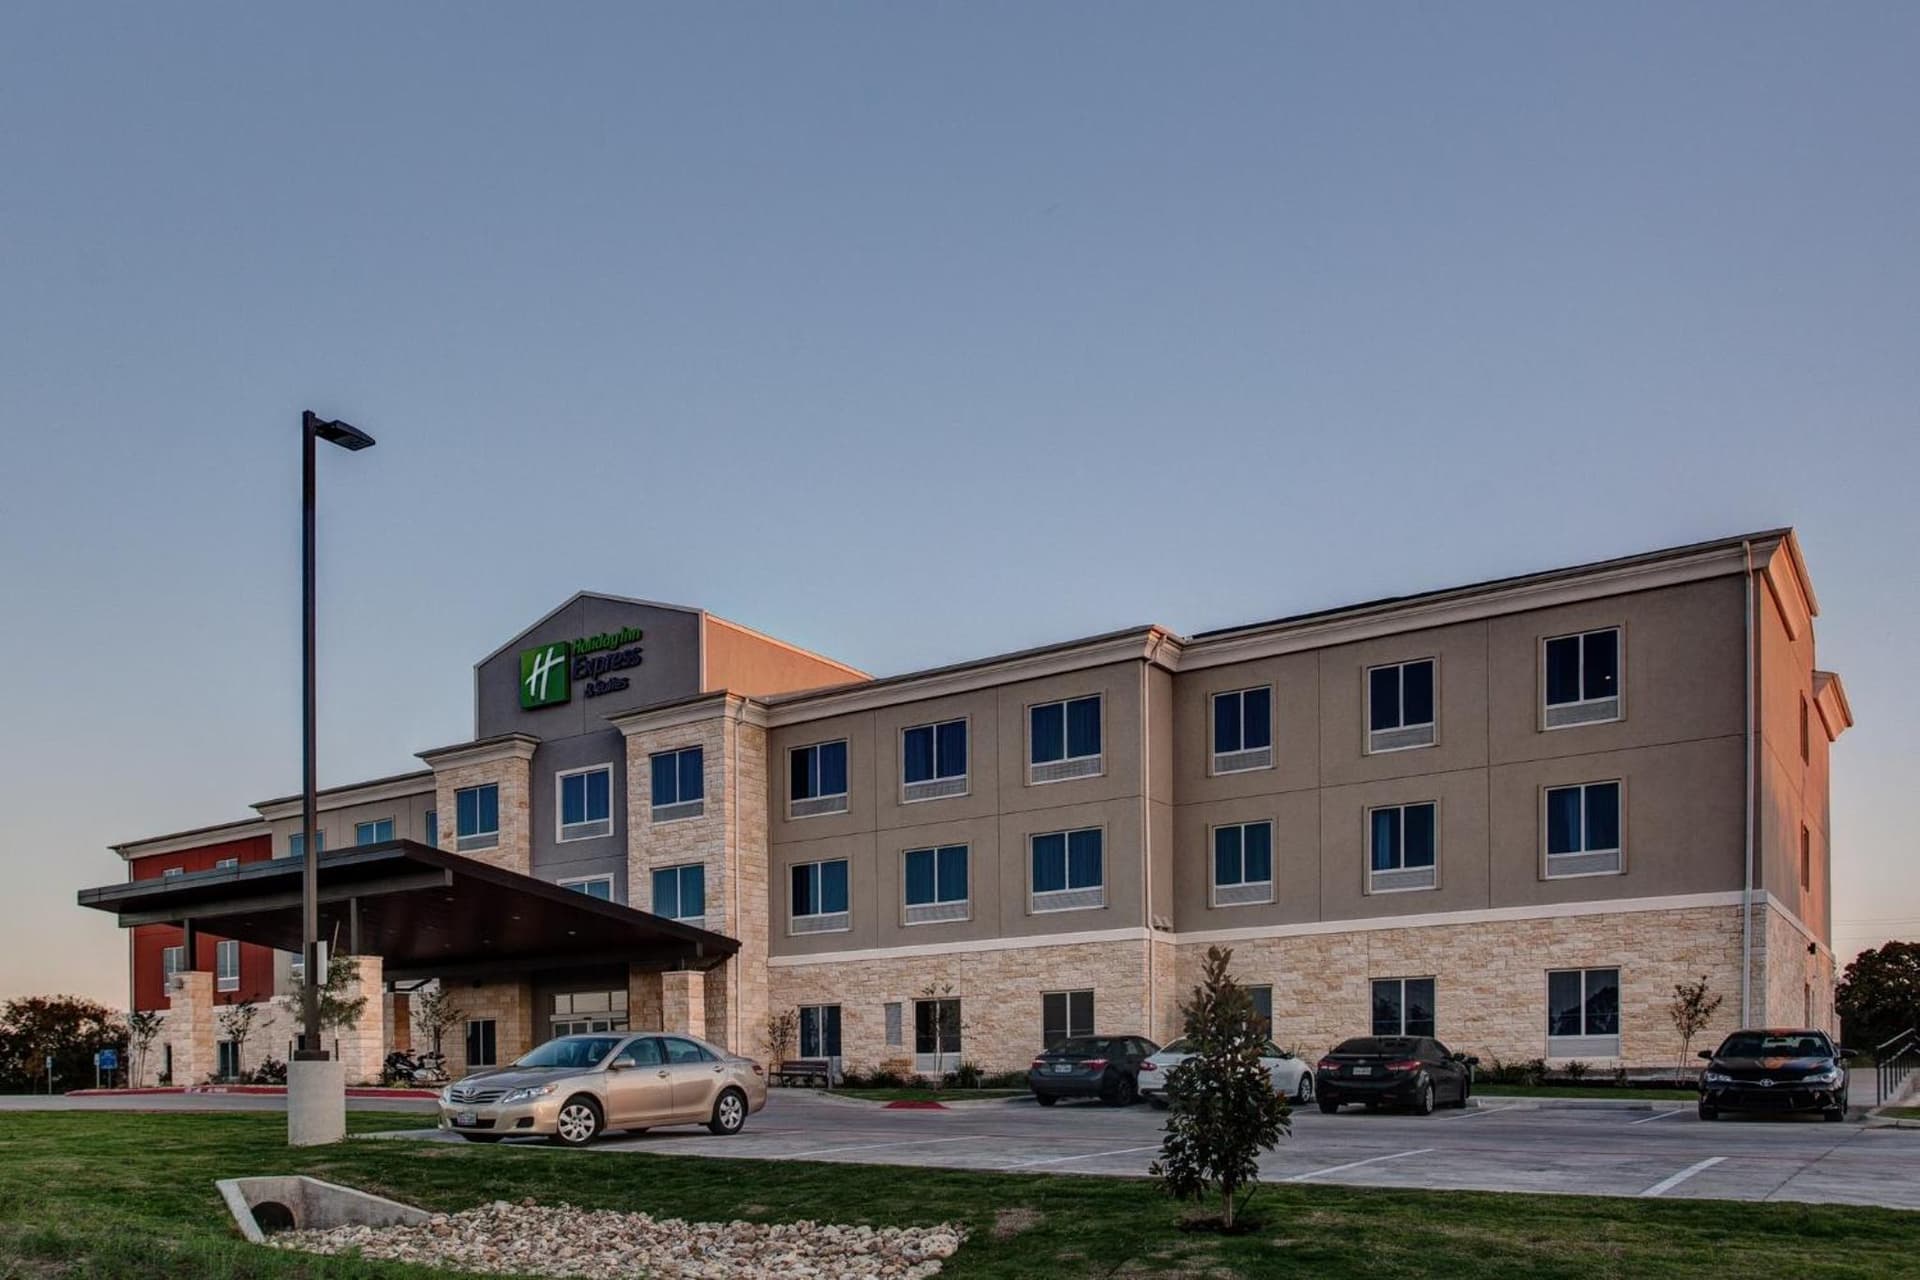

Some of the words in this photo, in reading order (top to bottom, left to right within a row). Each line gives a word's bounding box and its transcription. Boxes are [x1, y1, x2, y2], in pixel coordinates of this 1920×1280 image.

[573, 634, 620, 655] Holiday
[619, 626, 643, 645] Inn
[573, 647, 643, 681] Express
[594, 677, 629, 696] Suites
